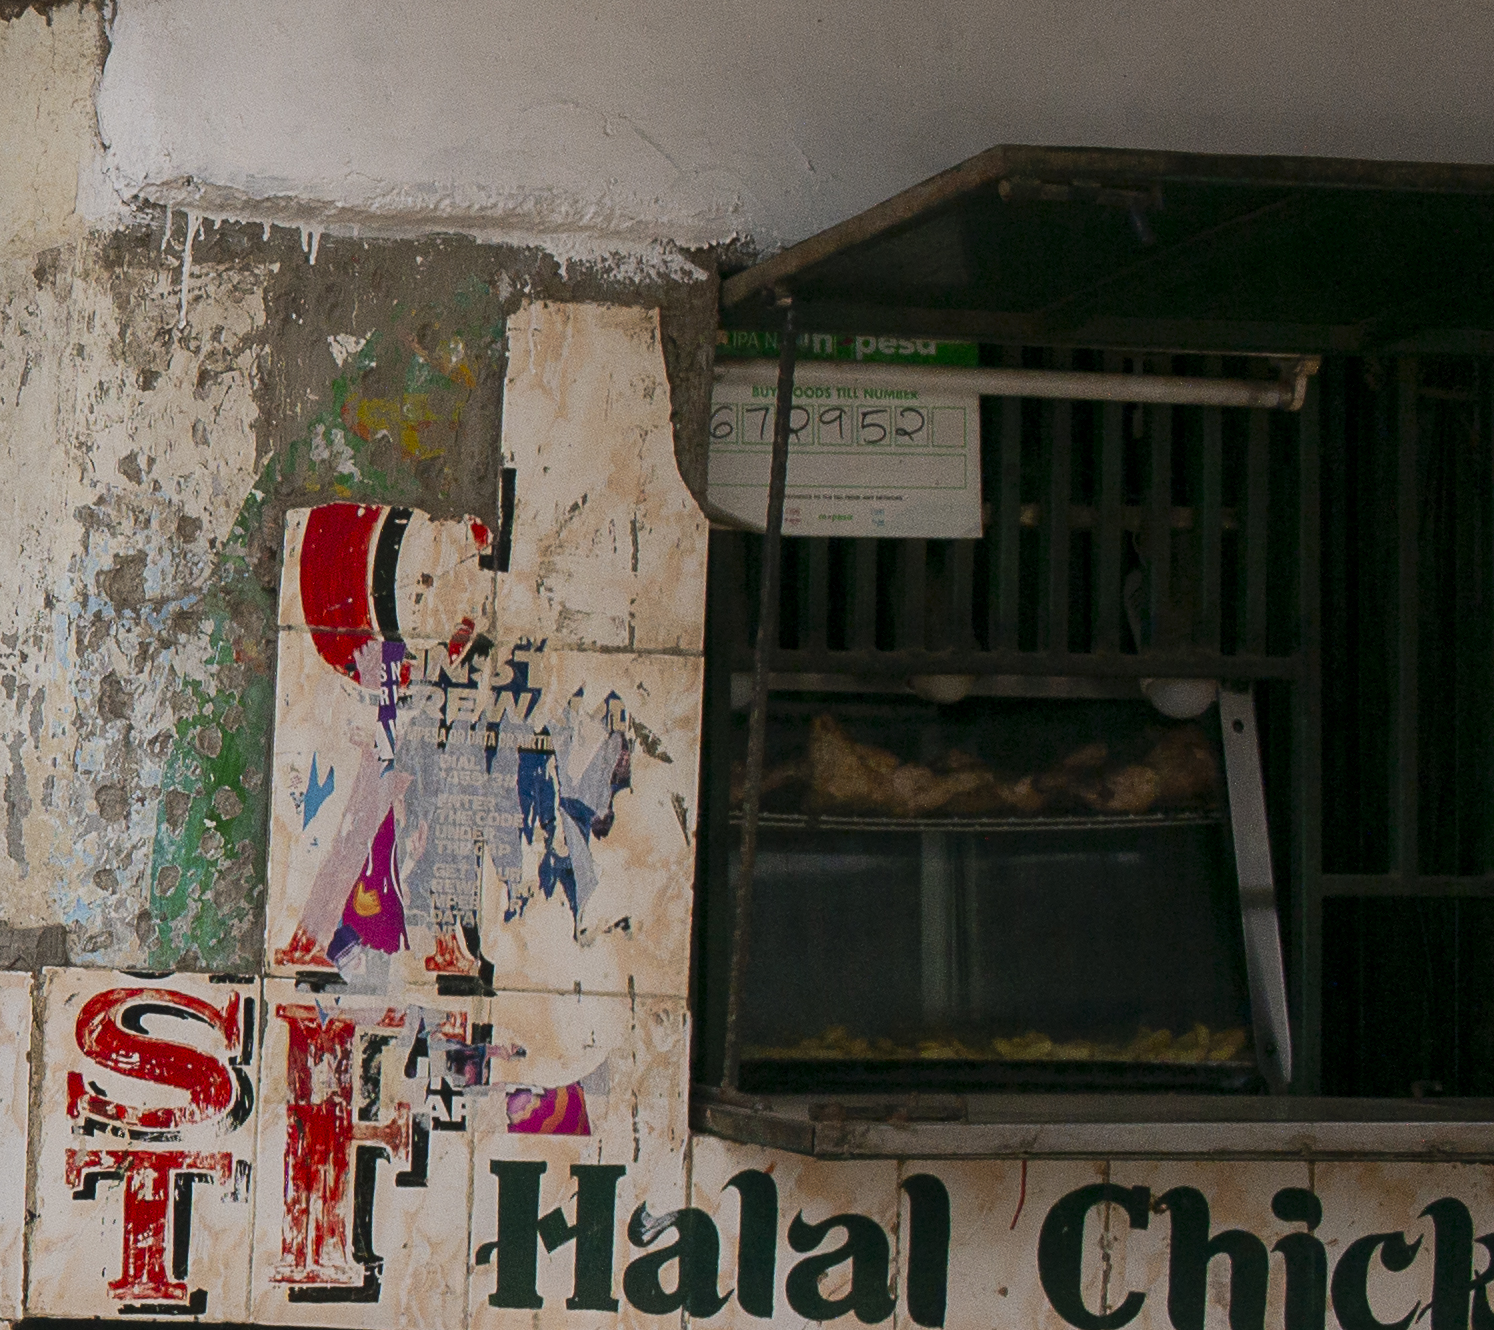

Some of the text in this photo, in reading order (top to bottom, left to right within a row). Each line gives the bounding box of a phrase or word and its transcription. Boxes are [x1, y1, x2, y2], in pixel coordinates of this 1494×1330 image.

[792, 386, 831, 400] OODS
[837, 388, 859, 401] TILL
[863, 389, 919, 401] NUMBER
[476, 1159, 951, 1330] Halal
